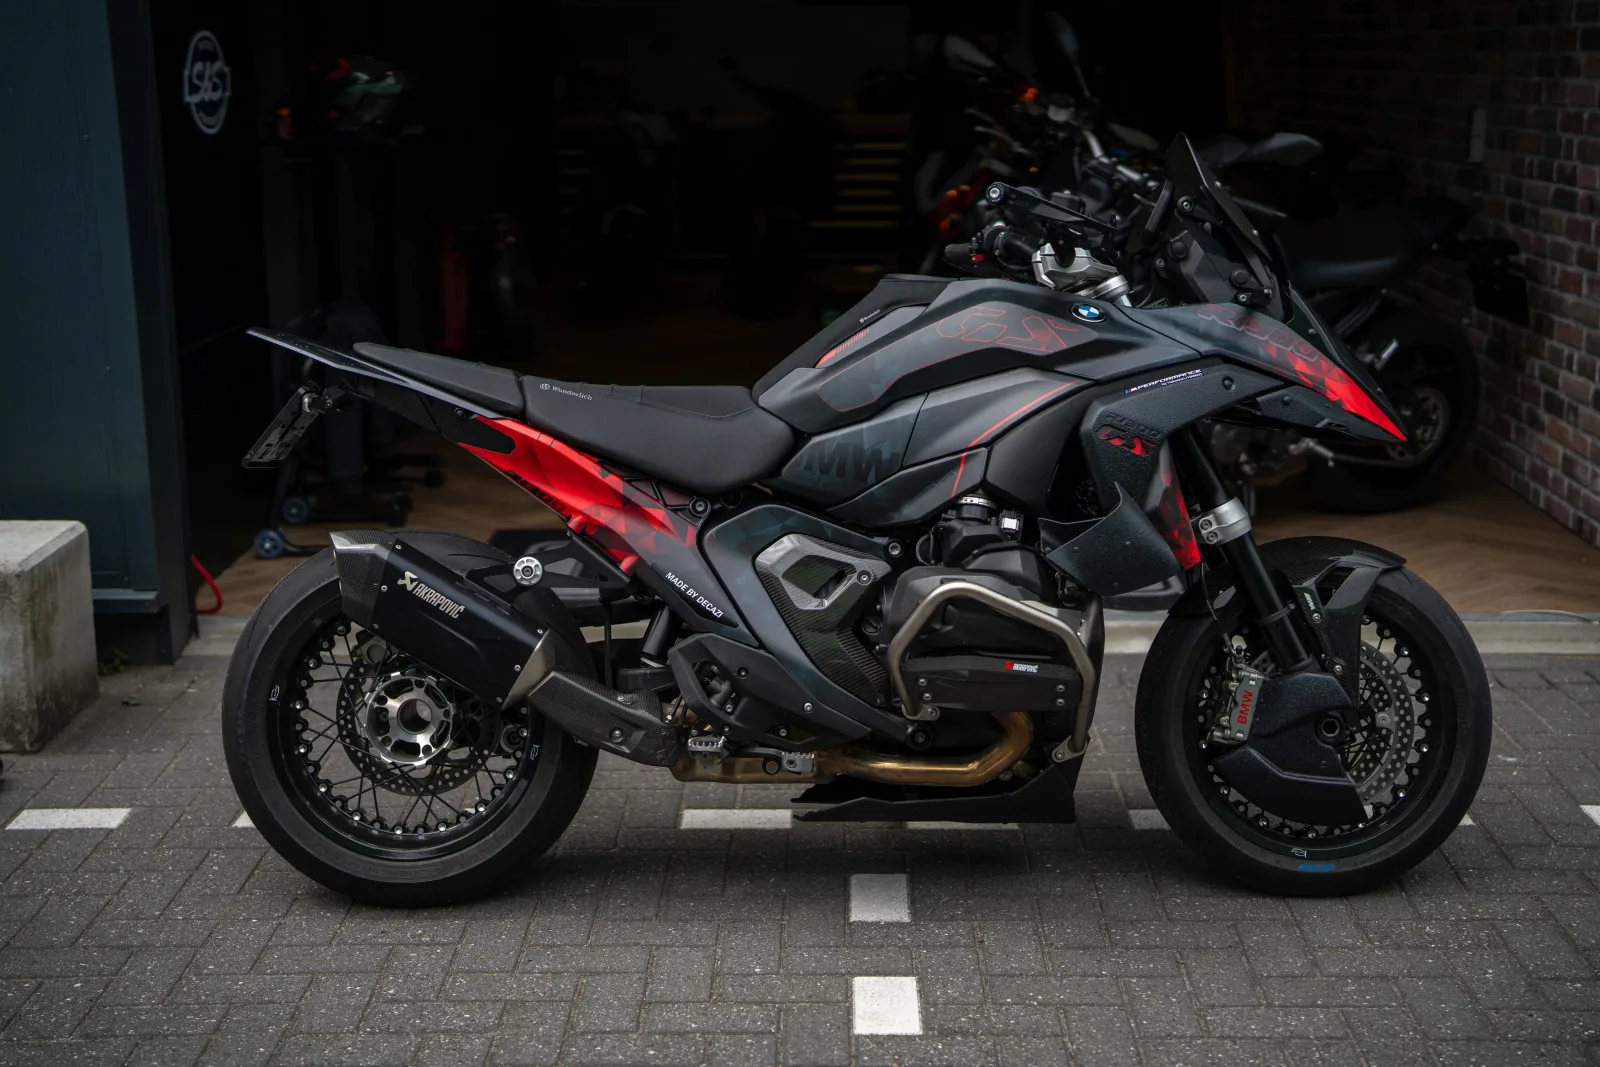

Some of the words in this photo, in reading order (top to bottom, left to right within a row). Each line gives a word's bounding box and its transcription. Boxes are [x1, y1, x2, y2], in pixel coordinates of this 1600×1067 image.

[552, 385, 592, 401] Wunderlich
[665, 572, 689, 592] MADE
[686, 588, 699, 599] BY
[696, 596, 724, 619] DECAZI
[1236, 690, 1254, 725] BMW
